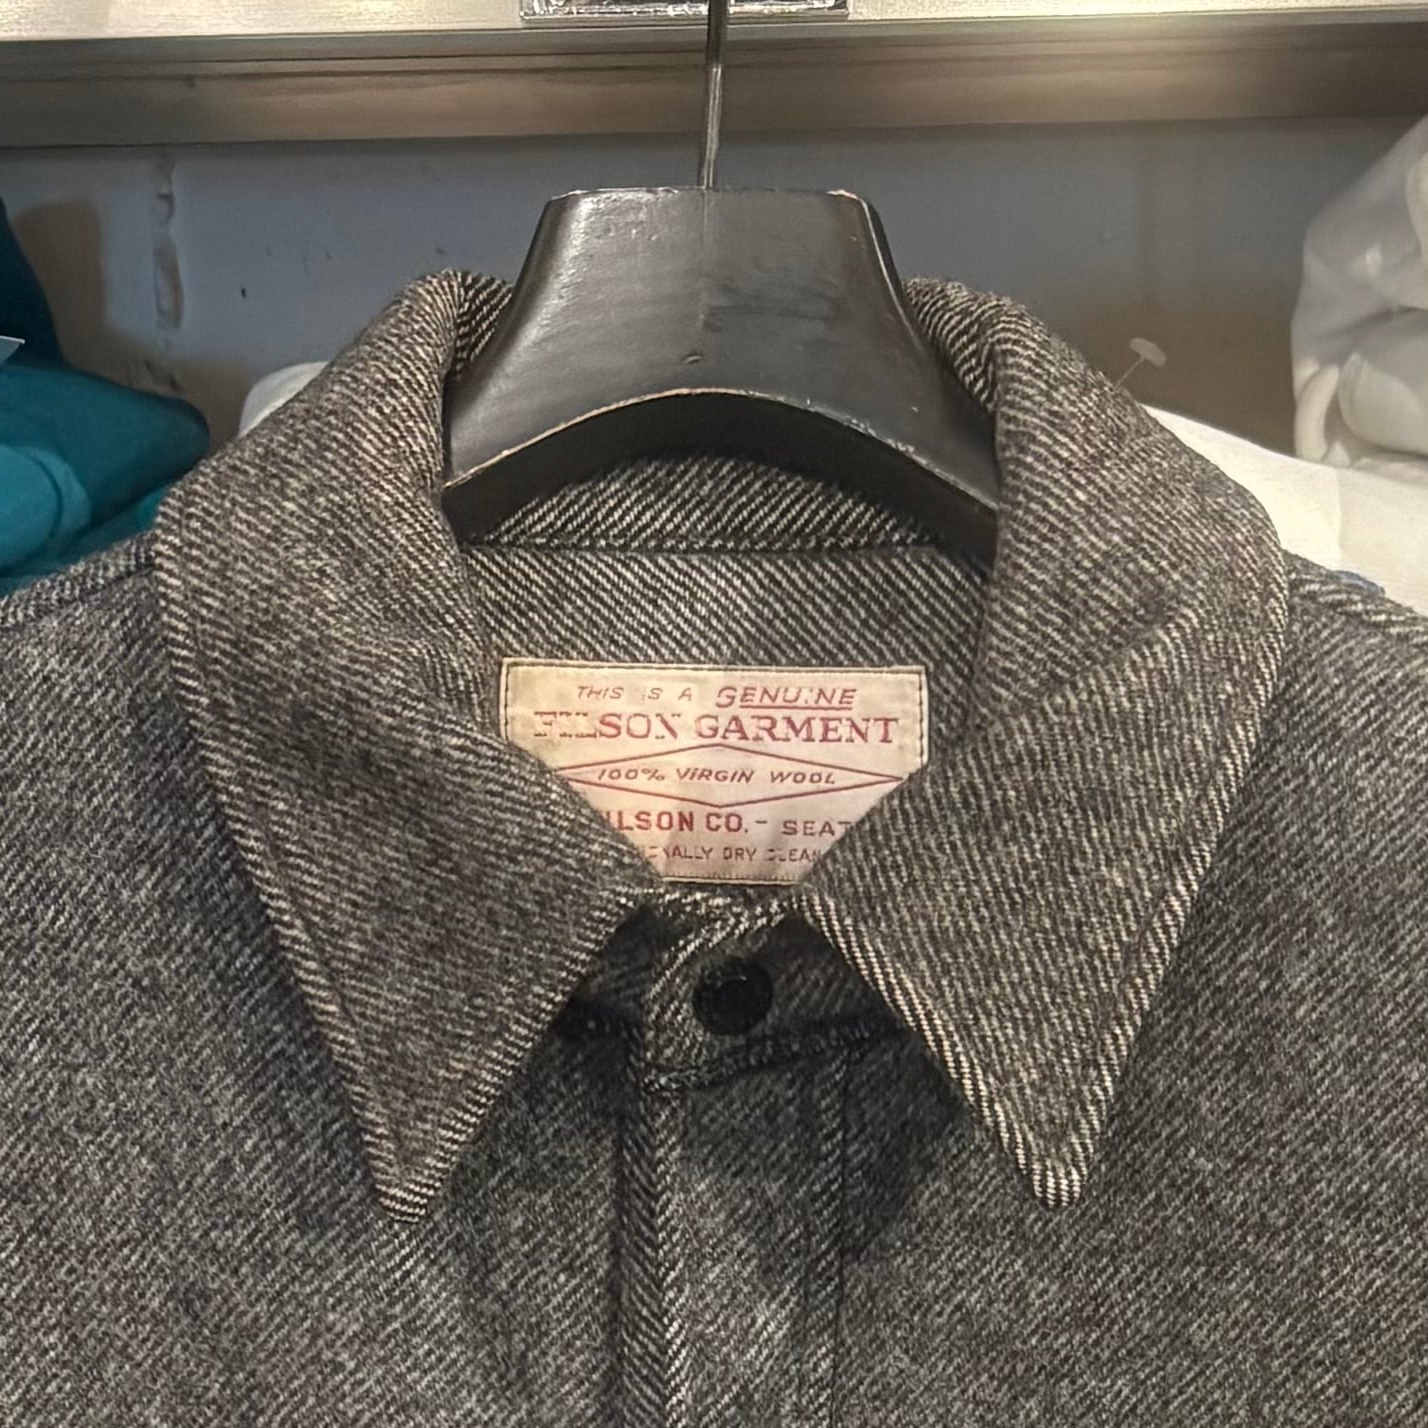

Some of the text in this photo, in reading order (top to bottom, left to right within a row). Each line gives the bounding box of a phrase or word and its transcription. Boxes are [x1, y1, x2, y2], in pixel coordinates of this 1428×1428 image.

[577, 685, 625, 701] THIS
[641, 686, 664, 702] S
[677, 686, 694, 702] A
[694, 714, 900, 744] GARMENT
[597, 767, 837, 785] 100% VIRGIN WOOL
[705, 811, 750, 834] CO.
[722, 846, 758, 862] DRY
